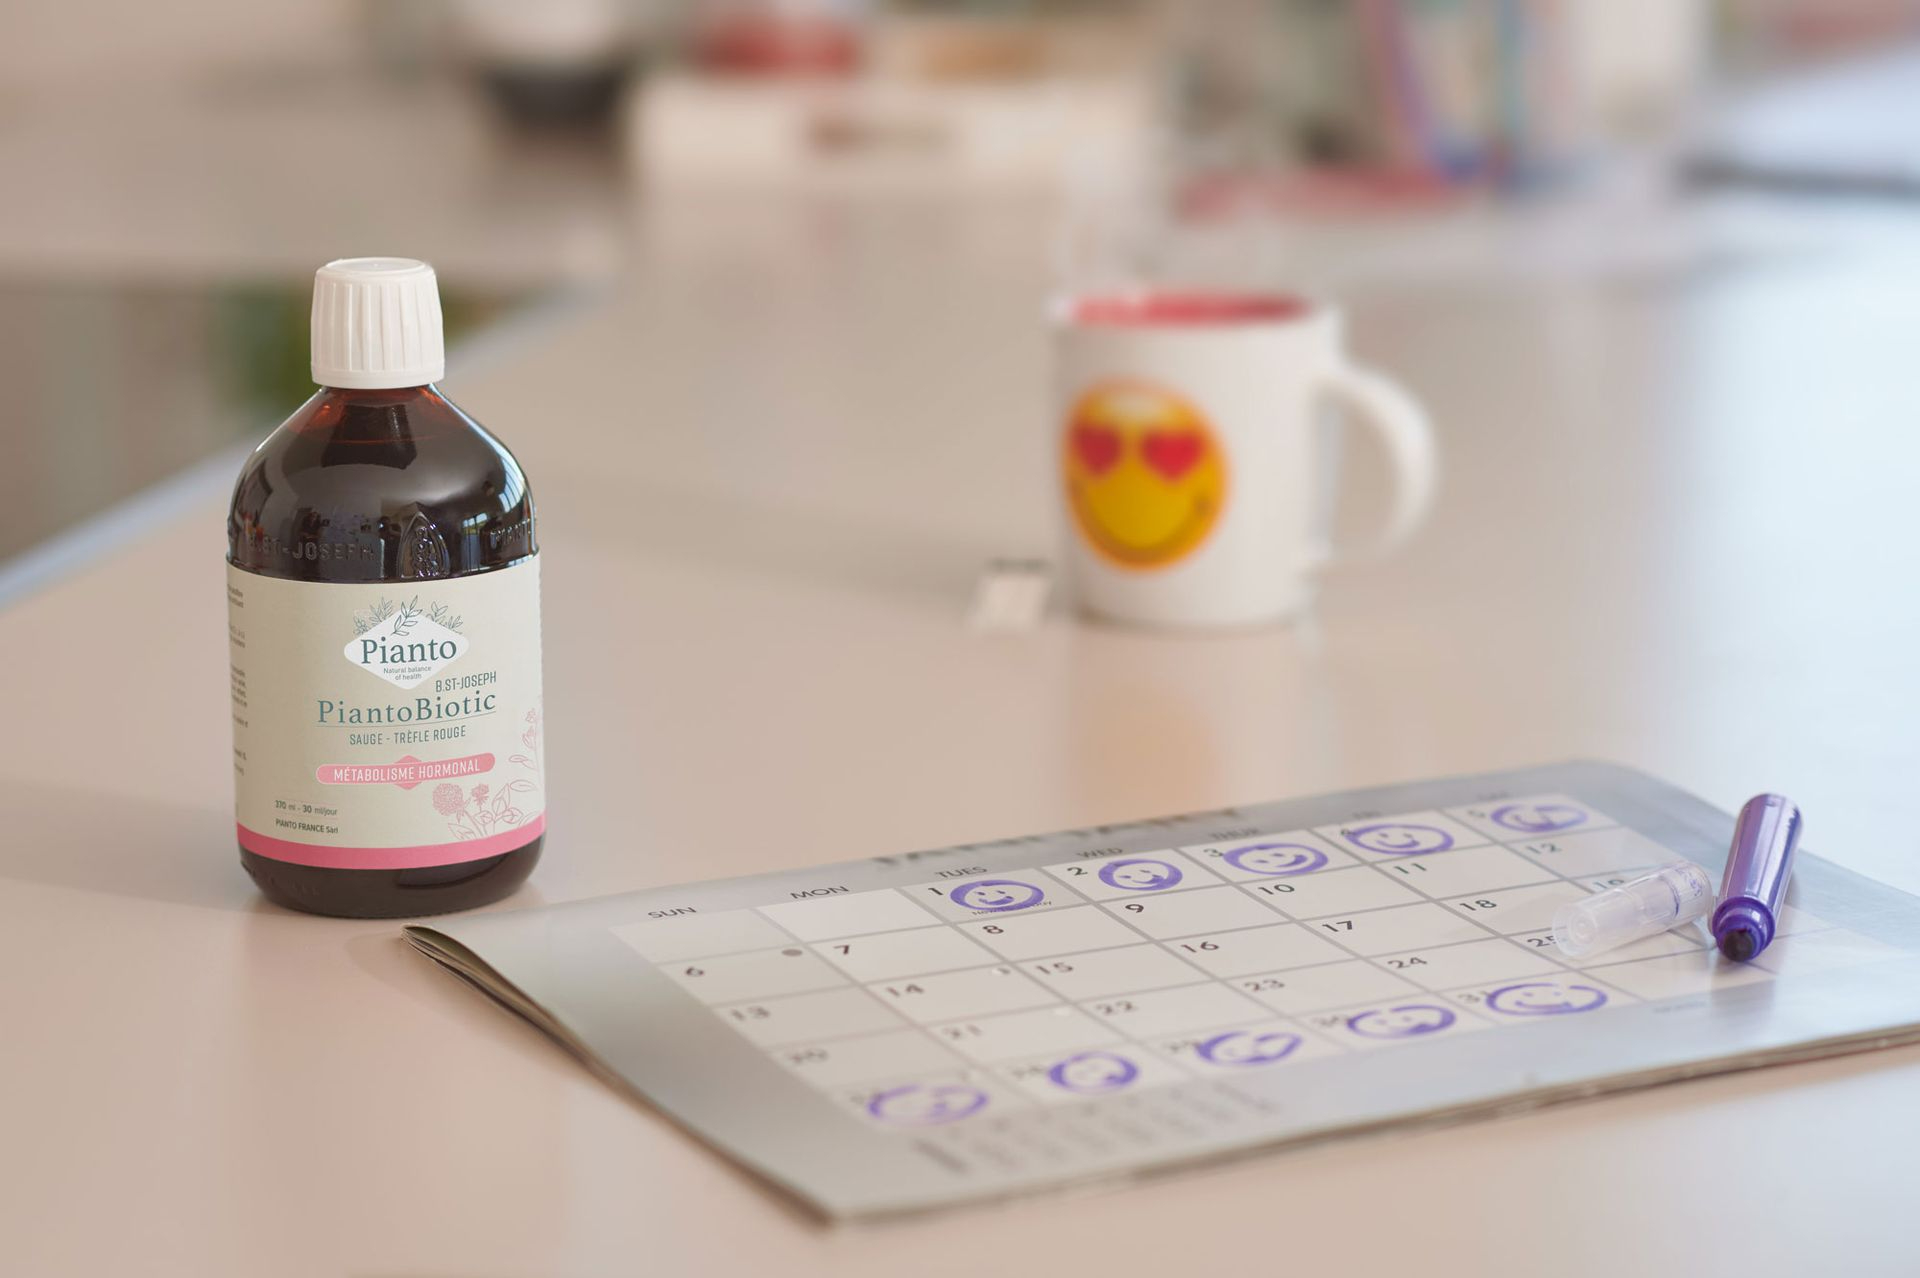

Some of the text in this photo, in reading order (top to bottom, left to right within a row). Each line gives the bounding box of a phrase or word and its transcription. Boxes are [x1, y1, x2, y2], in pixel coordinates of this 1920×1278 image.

[361, 636, 457, 664] Pianto
[383, 665, 432, 675] Natural balance
[435, 671, 497, 693] B.ST-JOSEPH
[317, 690, 496, 724] PiantoBiotic
[350, 733, 383, 746] SAUGE
[394, 729, 430, 744] TRÈFLE
[433, 725, 467, 742] ROUGE
[333, 759, 480, 783] MÉTABOLISME HORMONAL
[275, 800, 287, 810] 370
[302, 804, 312, 813] 30
[275, 818, 297, 829] PIANTO
[298, 822, 325, 833] FRANCE
[1076, 847, 1124, 859] WED
[1203, 847, 1225, 858] 3
[1525, 842, 1562, 855] 12
[935, 866, 988, 878] TUES
[1066, 866, 1089, 876] 2
[1394, 862, 1427, 874] 11
[790, 885, 850, 899] MON
[928, 887, 944, 896] 1
[1258, 883, 1295, 895] 10
[1125, 903, 1145, 914] 9
[1459, 899, 1497, 911] 18
[647, 906, 697, 919] SUN
[982, 925, 1004, 934] 8
[1321, 920, 1353, 932] 17
[833, 944, 850, 955] 7
[1180, 941, 1220, 953] 16
[1036, 961, 1074, 975] 15
[1387, 956, 1428, 969] 24
[684, 966, 705, 978] 6
[885, 983, 926, 998] 14
[1243, 978, 1286, 992] 23
[730, 1005, 771, 1021] 13
